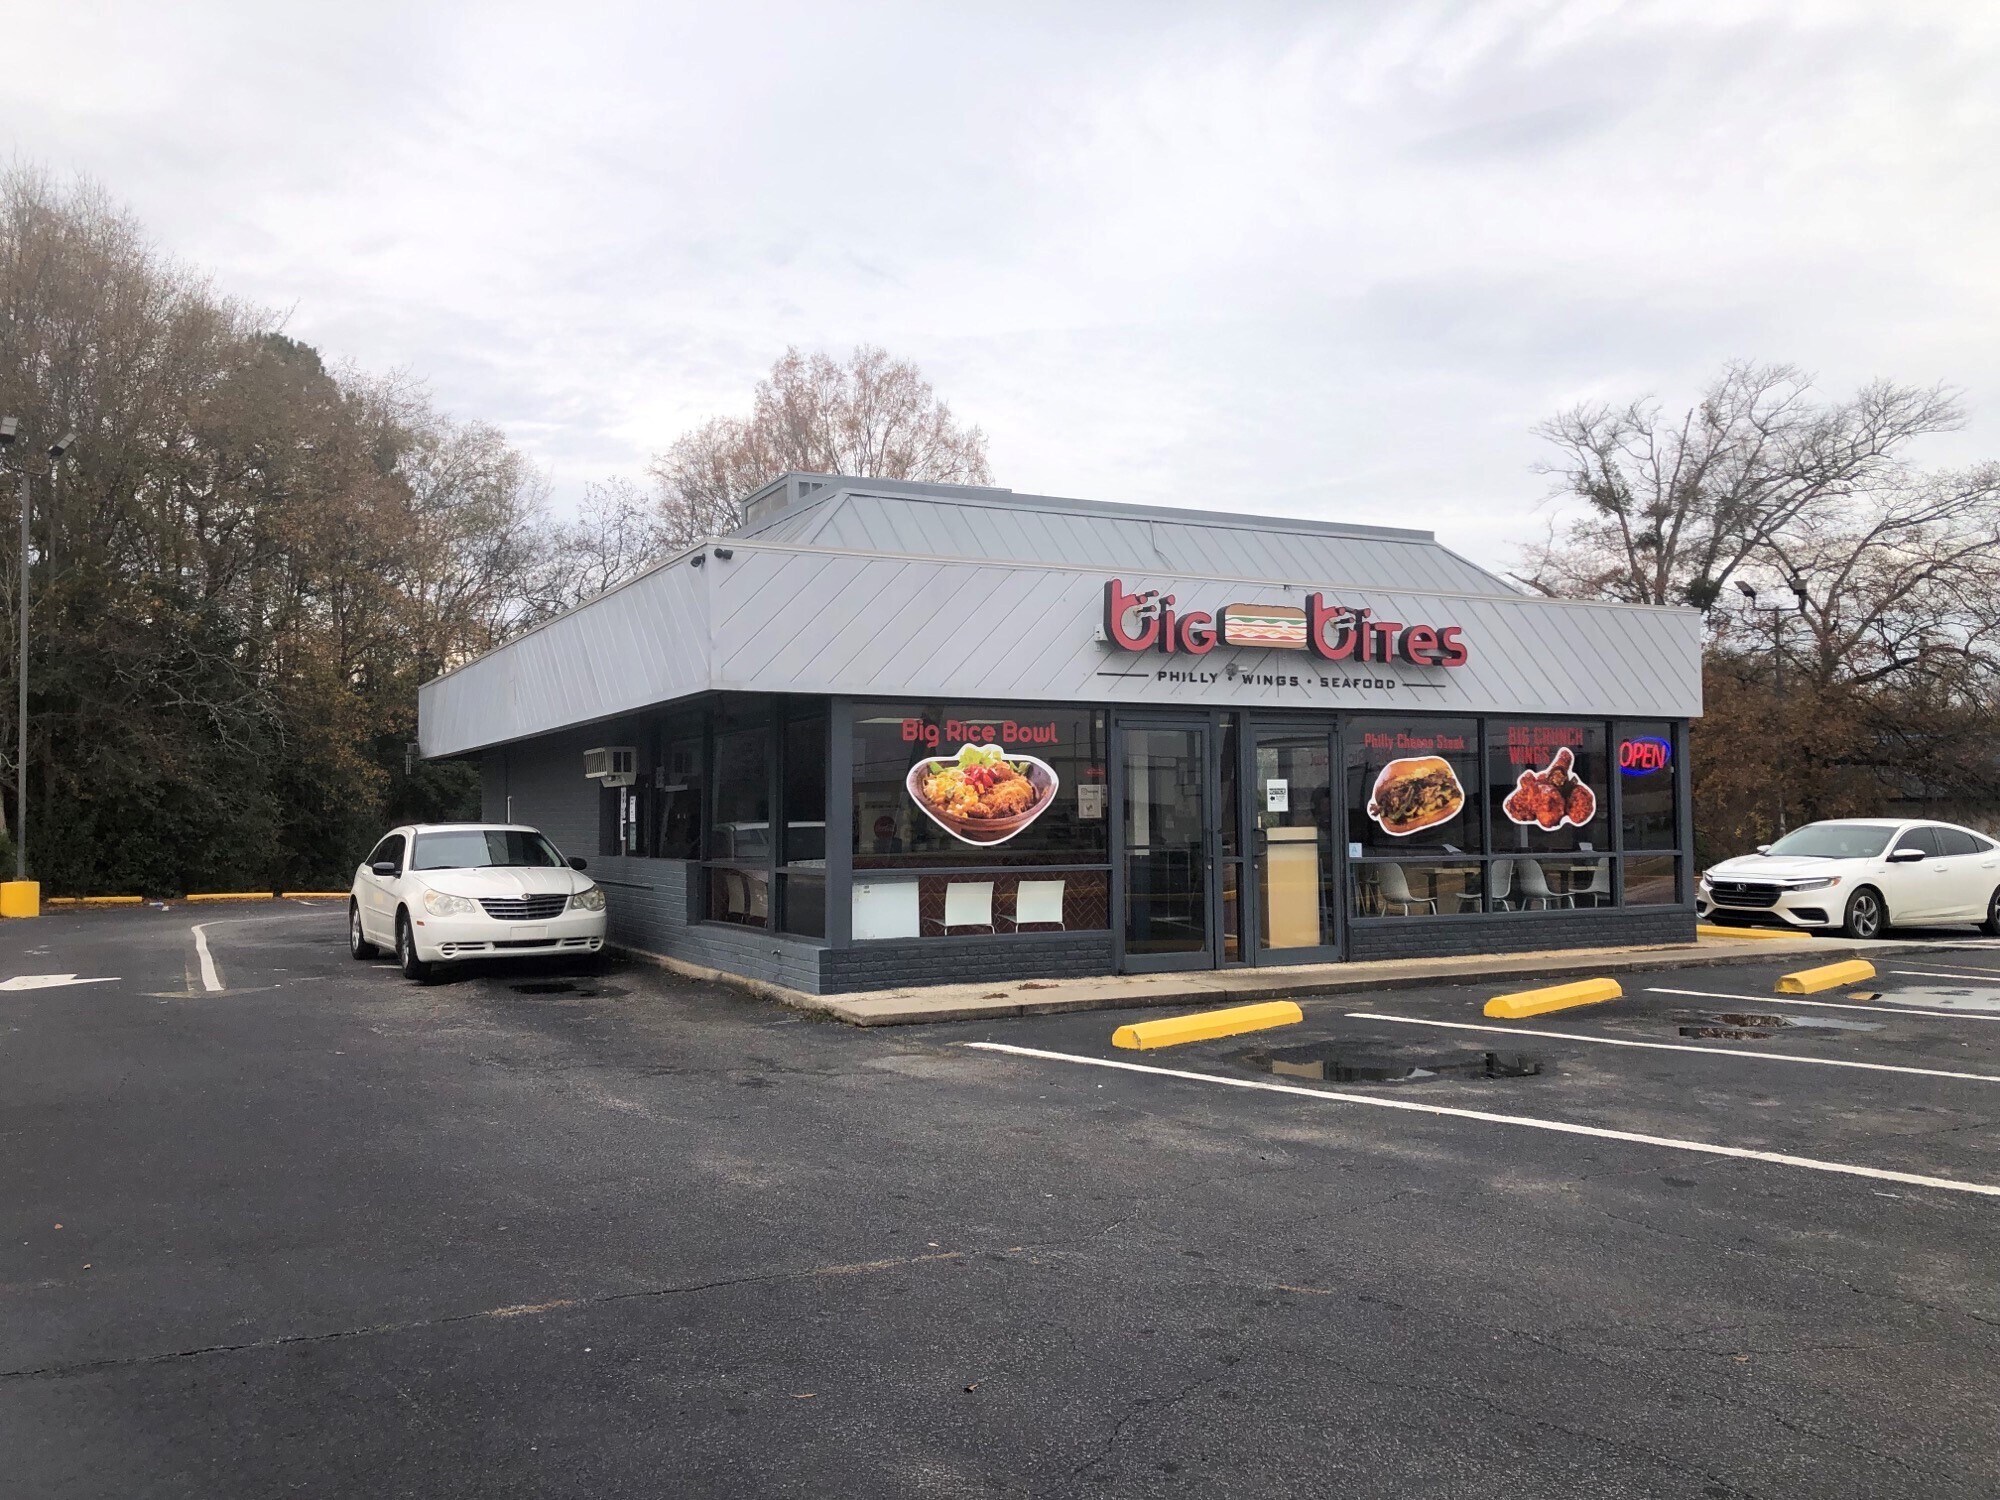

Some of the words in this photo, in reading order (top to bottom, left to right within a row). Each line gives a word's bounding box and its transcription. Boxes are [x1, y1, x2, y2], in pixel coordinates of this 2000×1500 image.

[1157, 671, 1218, 684] PHILLY
[1242, 674, 1299, 687] WINGS
[1320, 677, 1396, 690] SEAFOOD
[902, 719, 939, 748] Big
[946, 719, 996, 742] Rice
[1003, 720, 1058, 743] Bowl
[1364, 733, 1393, 750] Philly
[1508, 727, 1529, 745] BIG
[1533, 727, 1583, 745] CRUNCH
[1509, 746, 1550, 764] WINGS
[1619, 741, 1666, 768] OPEN
